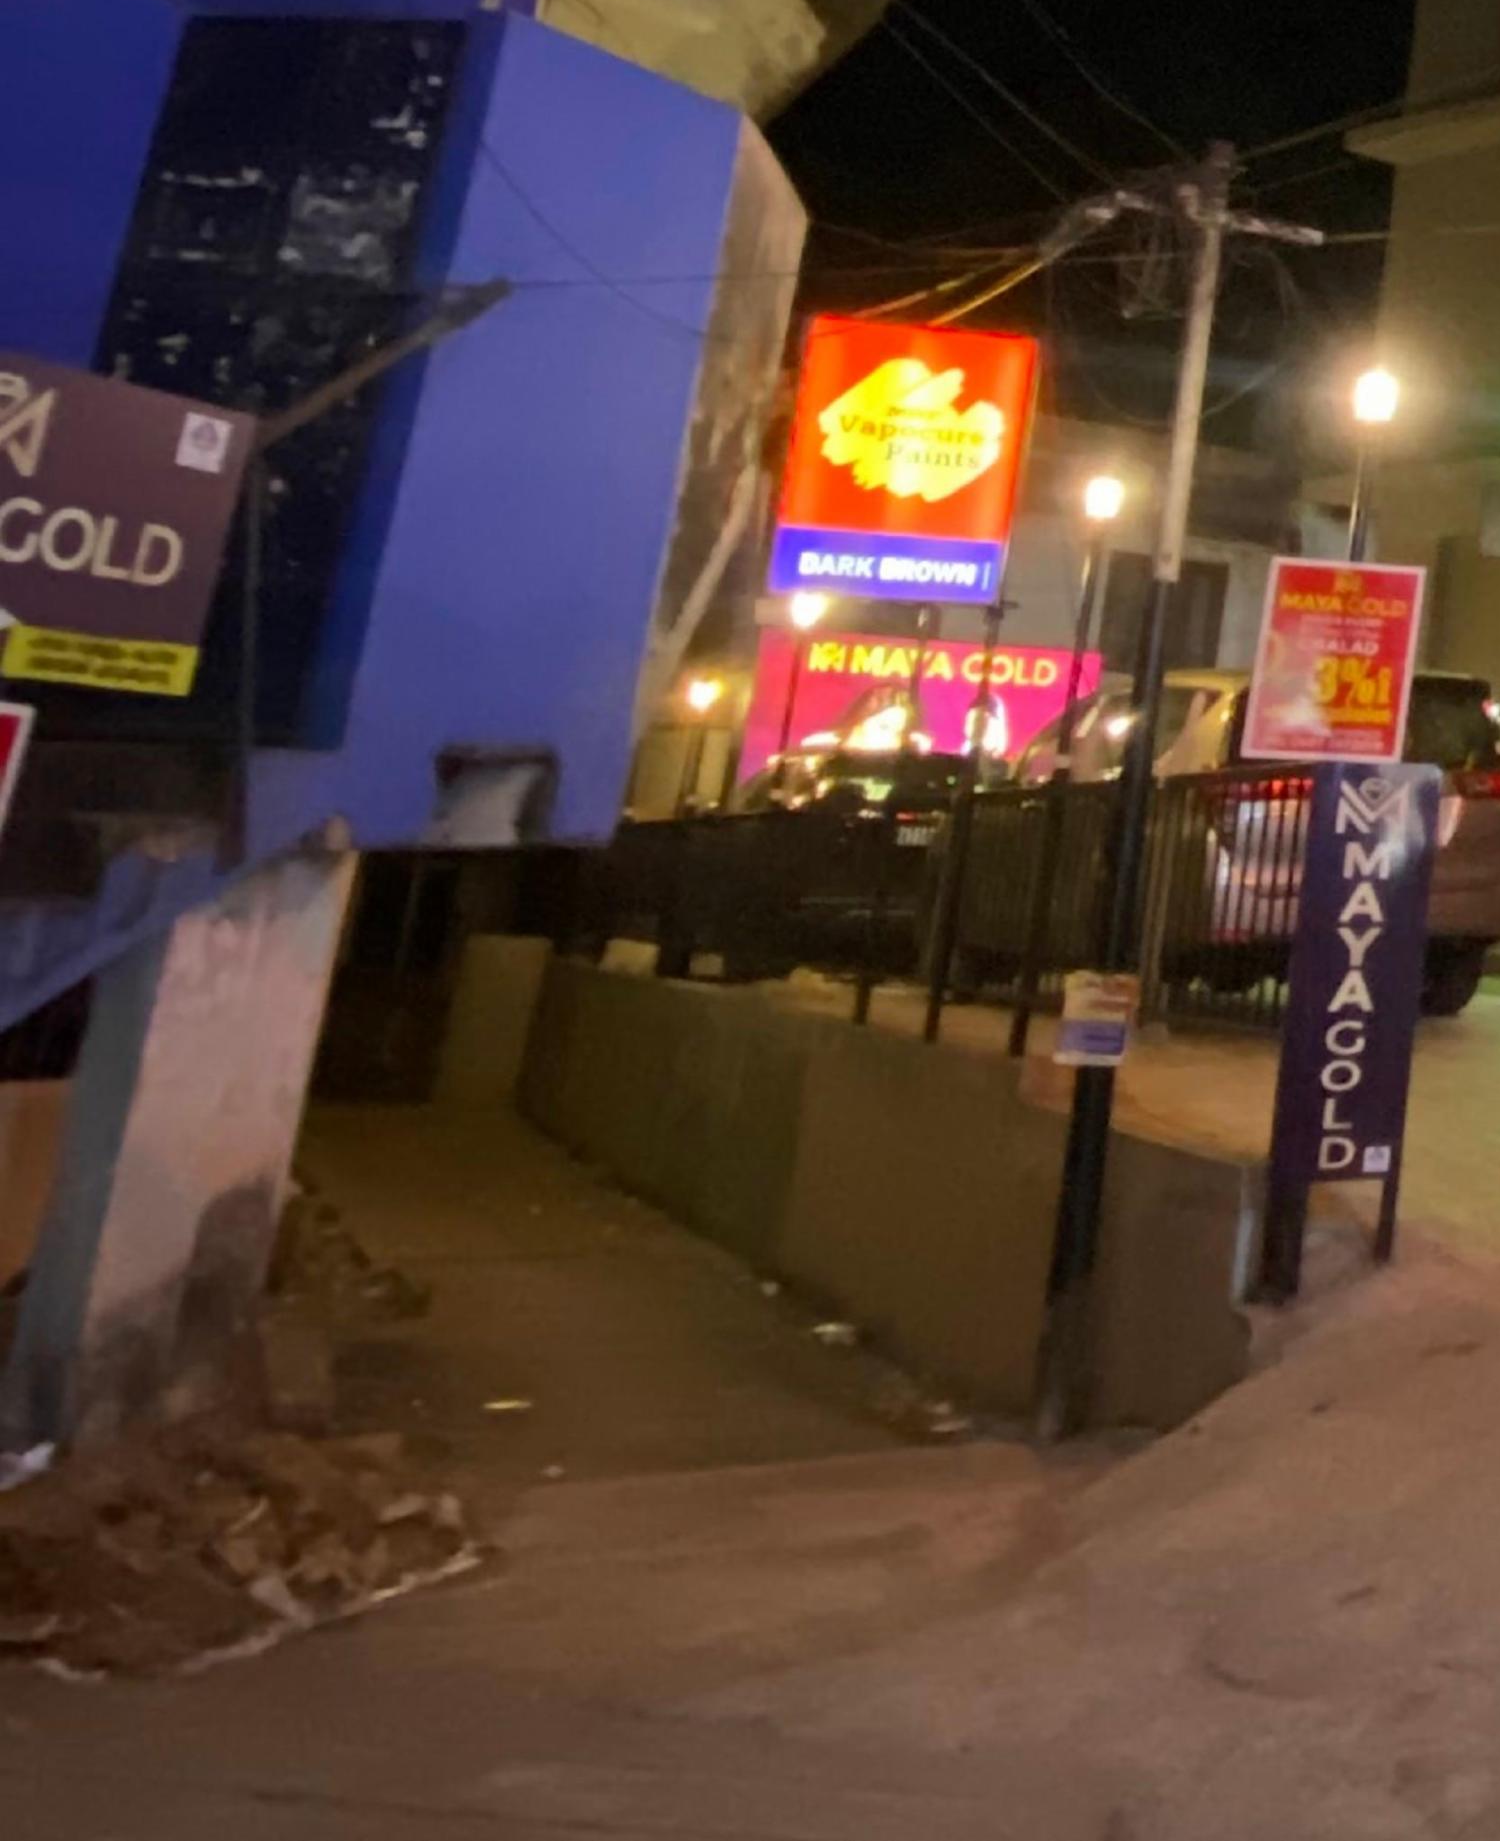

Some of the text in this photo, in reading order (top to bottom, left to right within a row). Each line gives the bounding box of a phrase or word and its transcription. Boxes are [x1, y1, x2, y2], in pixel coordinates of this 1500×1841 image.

[0, 496, 184, 587] GOLD
[798, 551, 876, 578] DARK
[851, 643, 954, 679] MAYA
